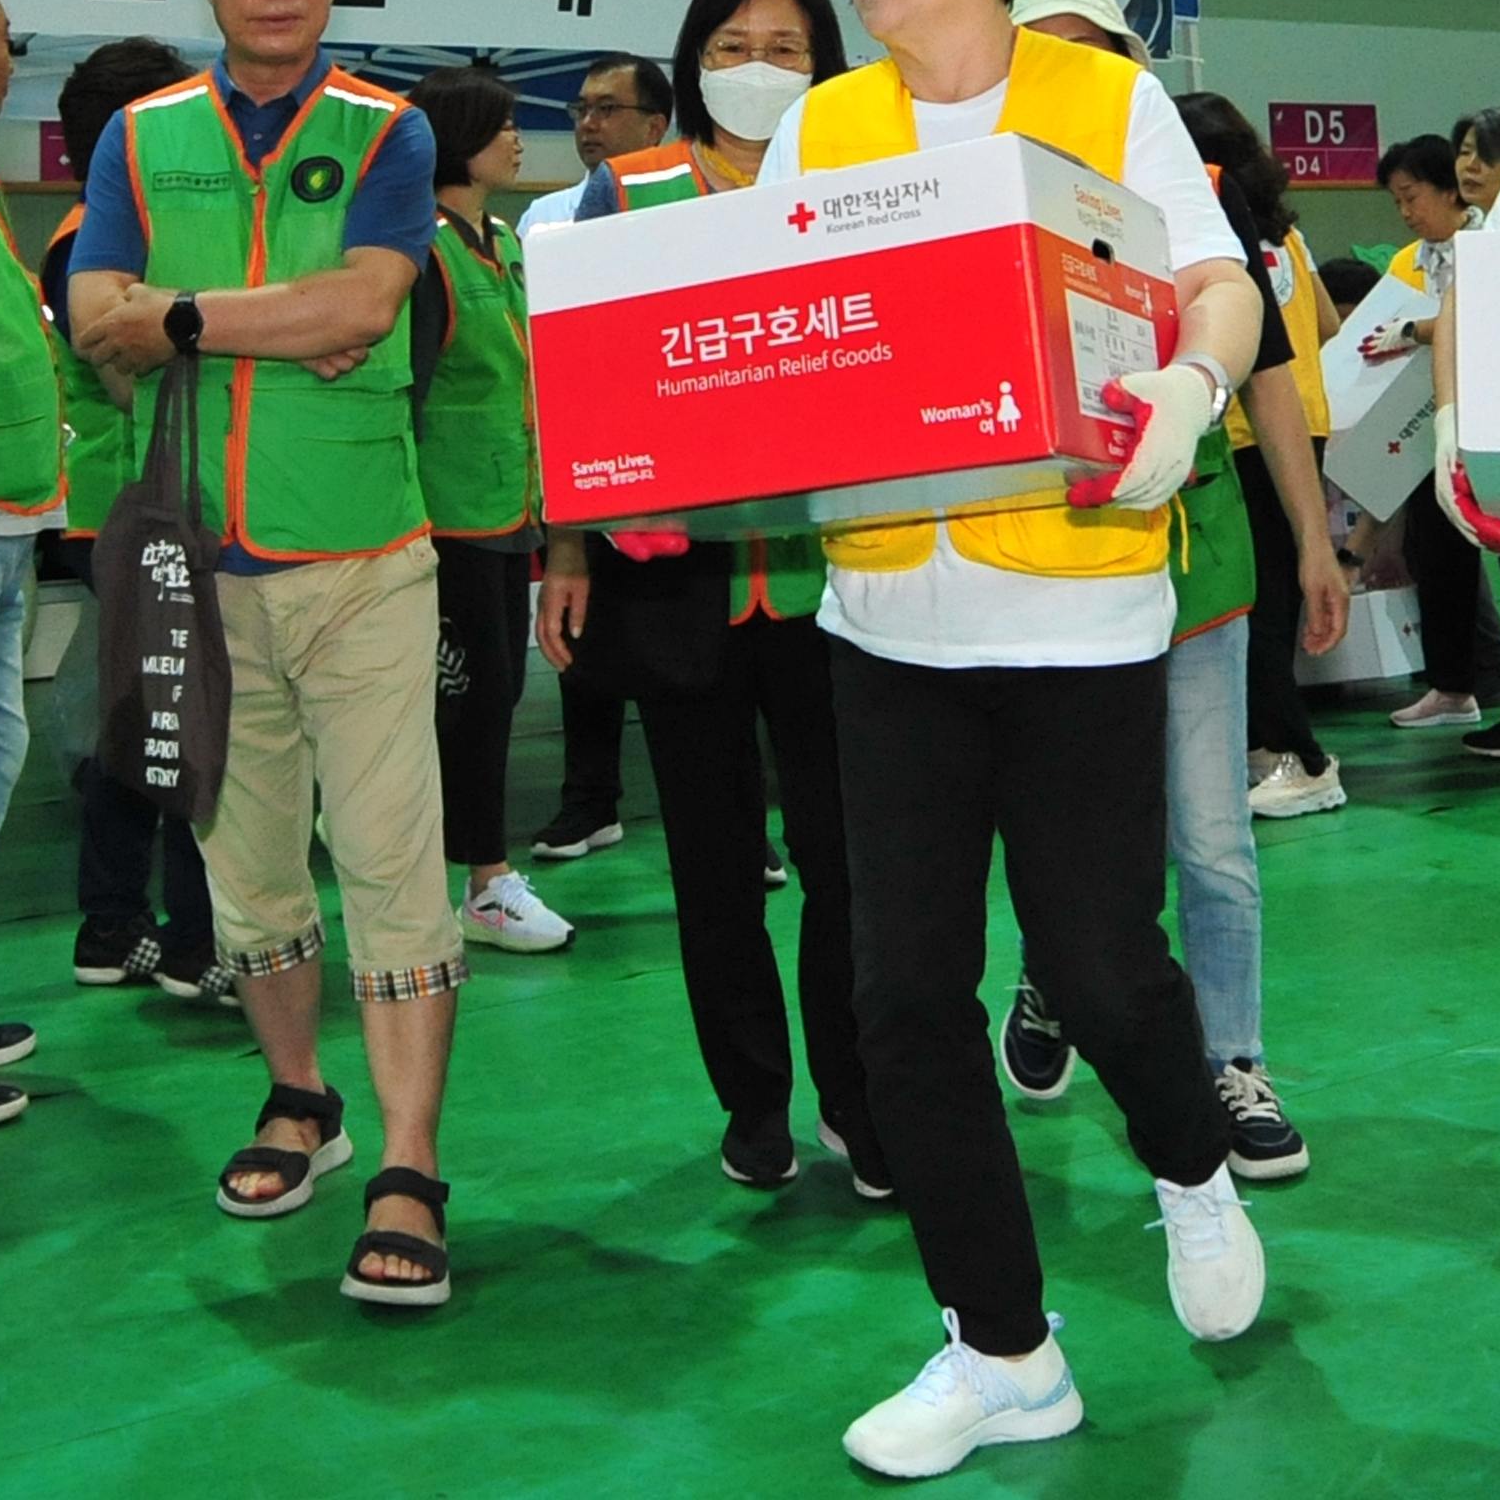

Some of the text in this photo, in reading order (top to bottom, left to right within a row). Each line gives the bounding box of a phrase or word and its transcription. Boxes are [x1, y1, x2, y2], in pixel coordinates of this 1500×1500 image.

[1304, 109, 1346, 145] D5
[1295, 155, 1321, 176] D4
[822, 177, 941, 220] 대한적십자사
[825, 208, 922, 235] Korean Red Cross
[660, 292, 880, 369] 긴급구호세트
[656, 341, 894, 398] Humanitarian Relief Goods
[920, 398, 994, 425] Woman's
[1398, 394, 1437, 440] 대한적십
[979, 417, 996, 436] 여
[571, 458, 617, 478] Saving
[170, 628, 189, 649] TE
